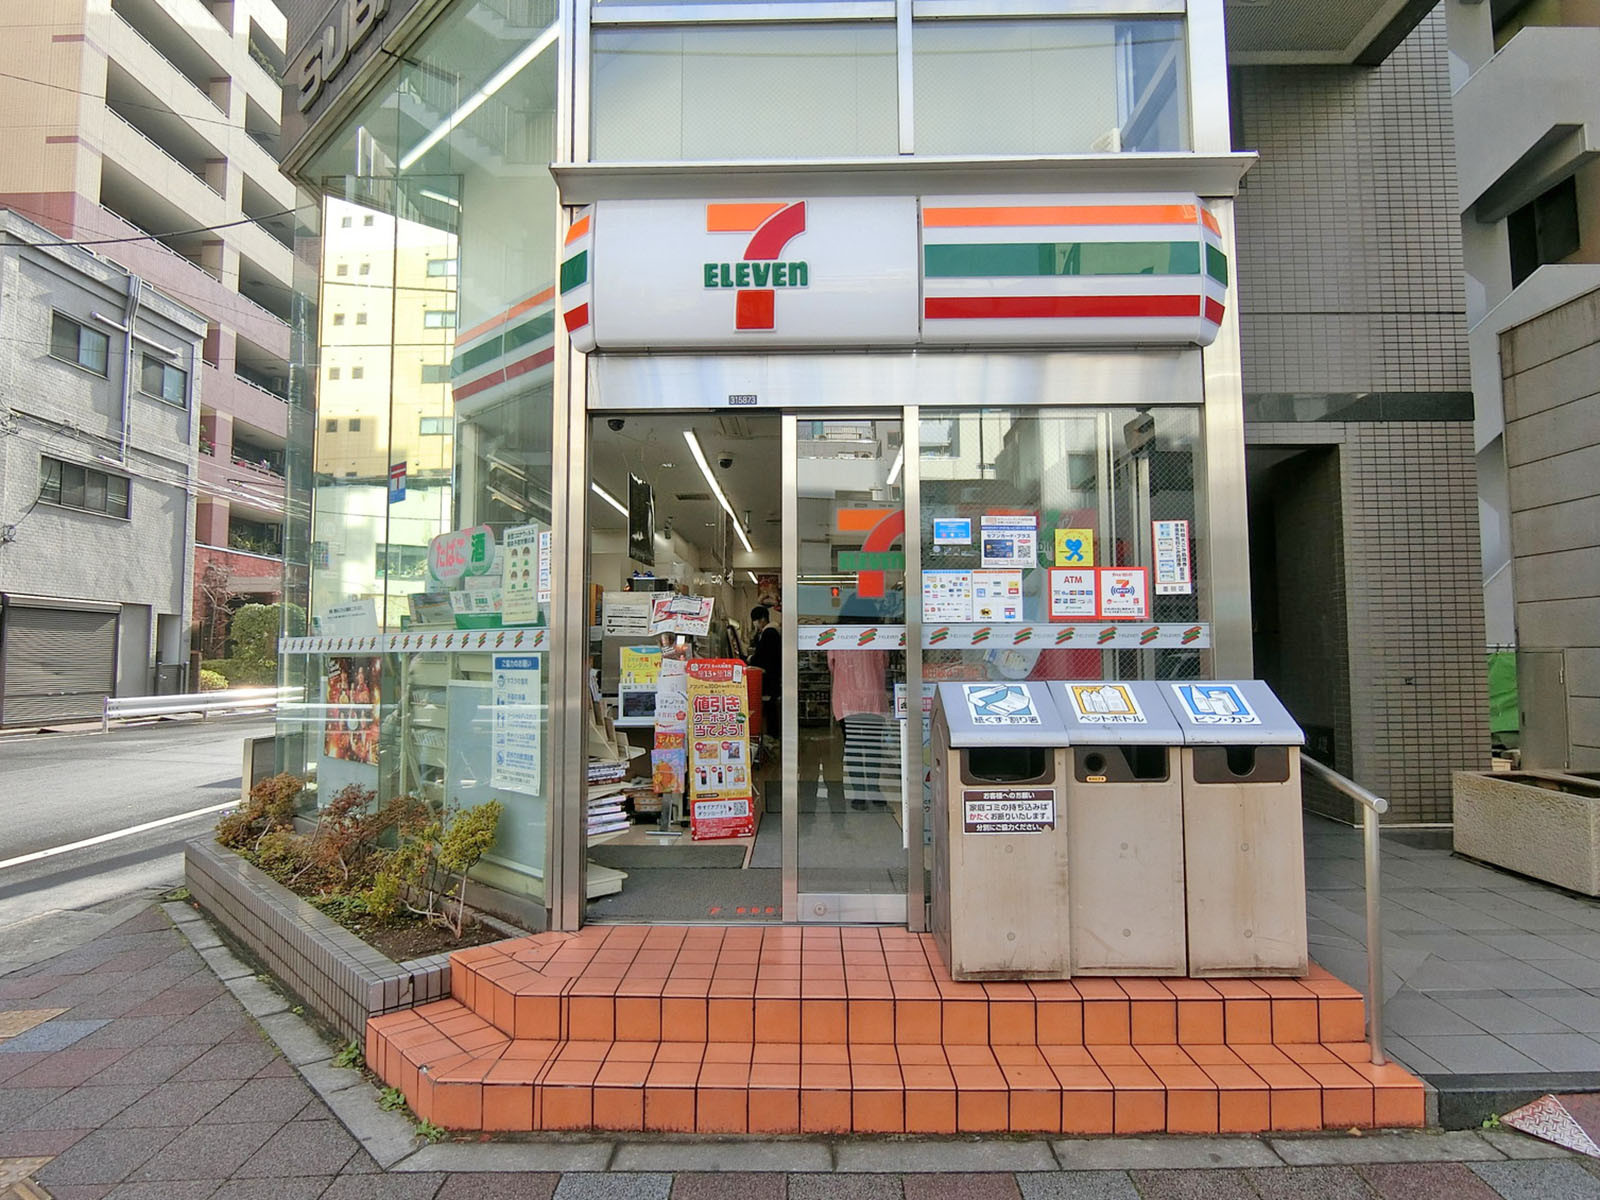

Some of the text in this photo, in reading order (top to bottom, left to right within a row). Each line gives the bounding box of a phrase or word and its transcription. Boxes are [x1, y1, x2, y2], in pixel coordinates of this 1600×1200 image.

[706, 200, 806, 331] 7
[1064, 575, 1083, 584] ATM
[693, 696, 740, 713] 値引き
[694, 713, 737, 723] クーポンを
[1080, 715, 1144, 723] ペットボトル
